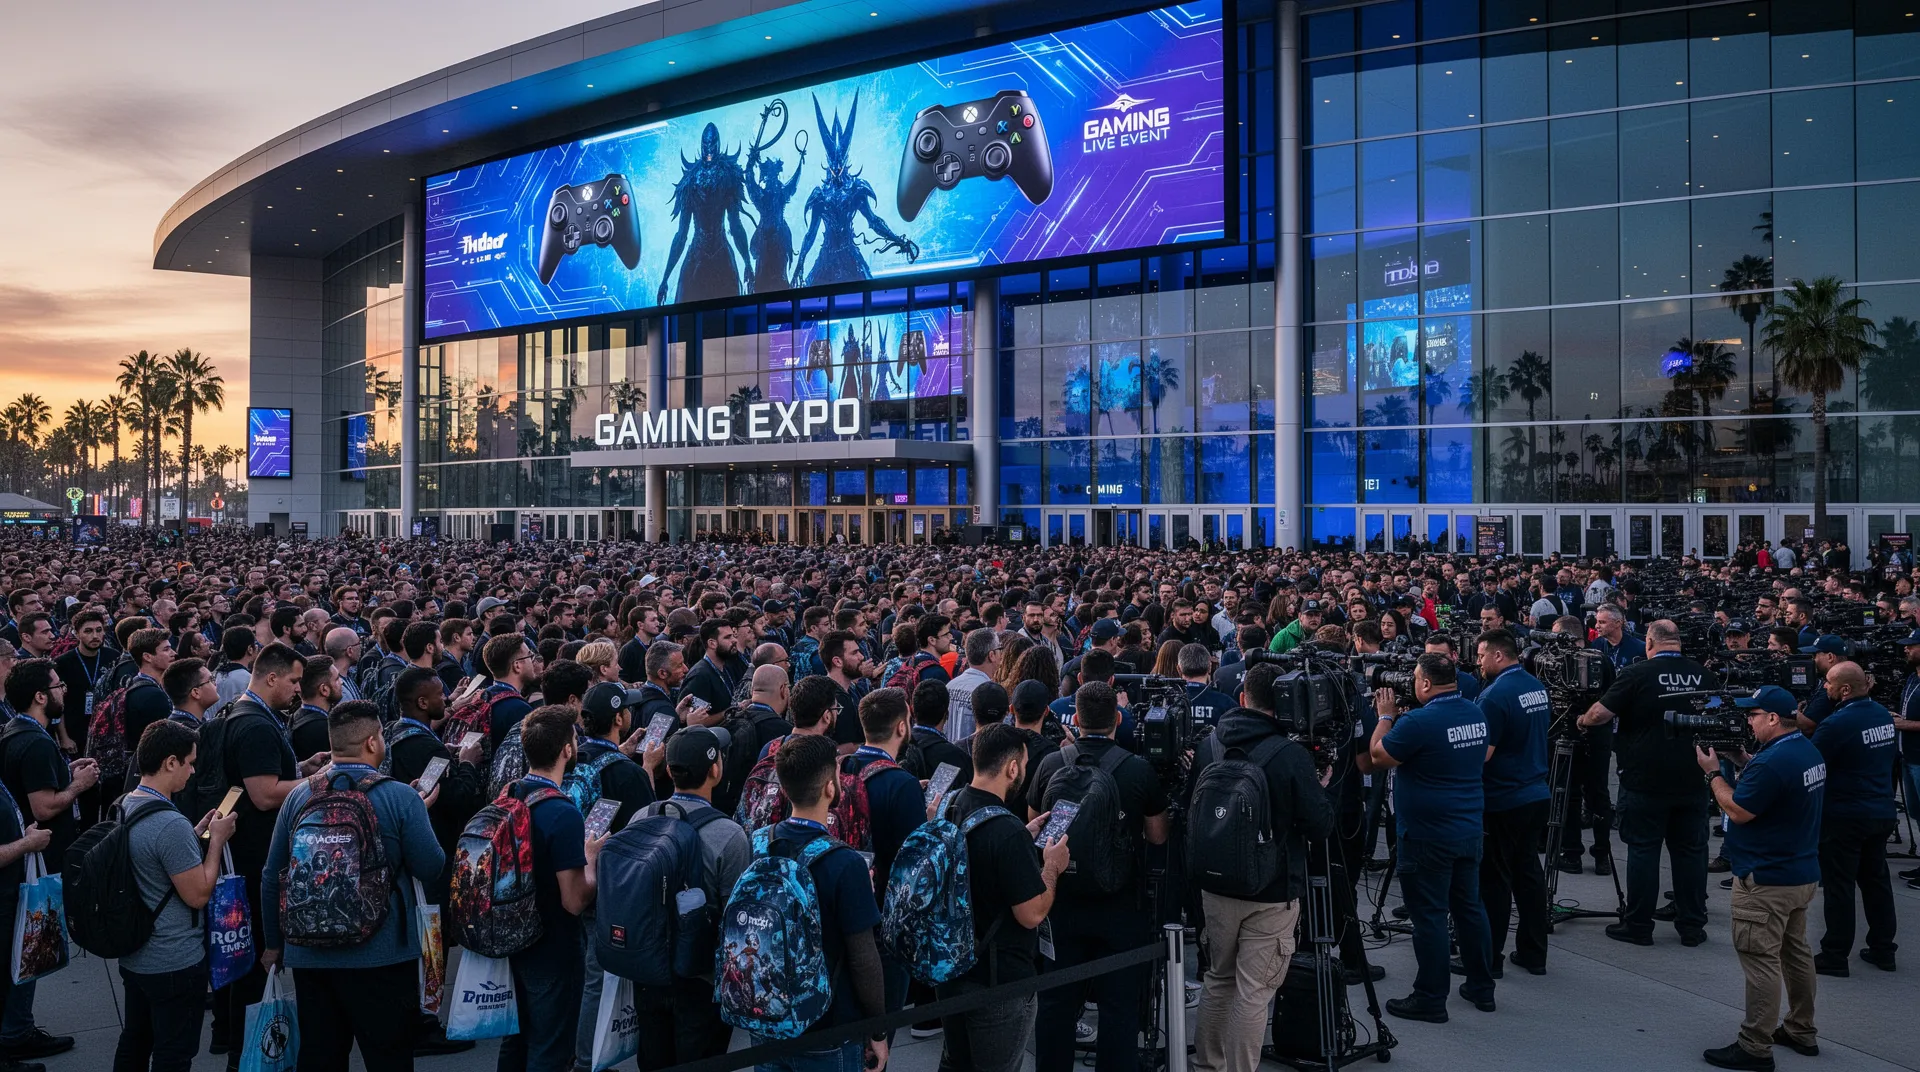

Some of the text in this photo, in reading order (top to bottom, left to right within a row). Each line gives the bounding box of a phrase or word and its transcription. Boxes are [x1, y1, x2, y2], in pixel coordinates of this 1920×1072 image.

[1083, 106, 1170, 139] GAMING
[1083, 126, 1170, 153] LIVE EVENT
[595, 405, 731, 446] GAMING
[749, 397, 860, 438] EXPO
